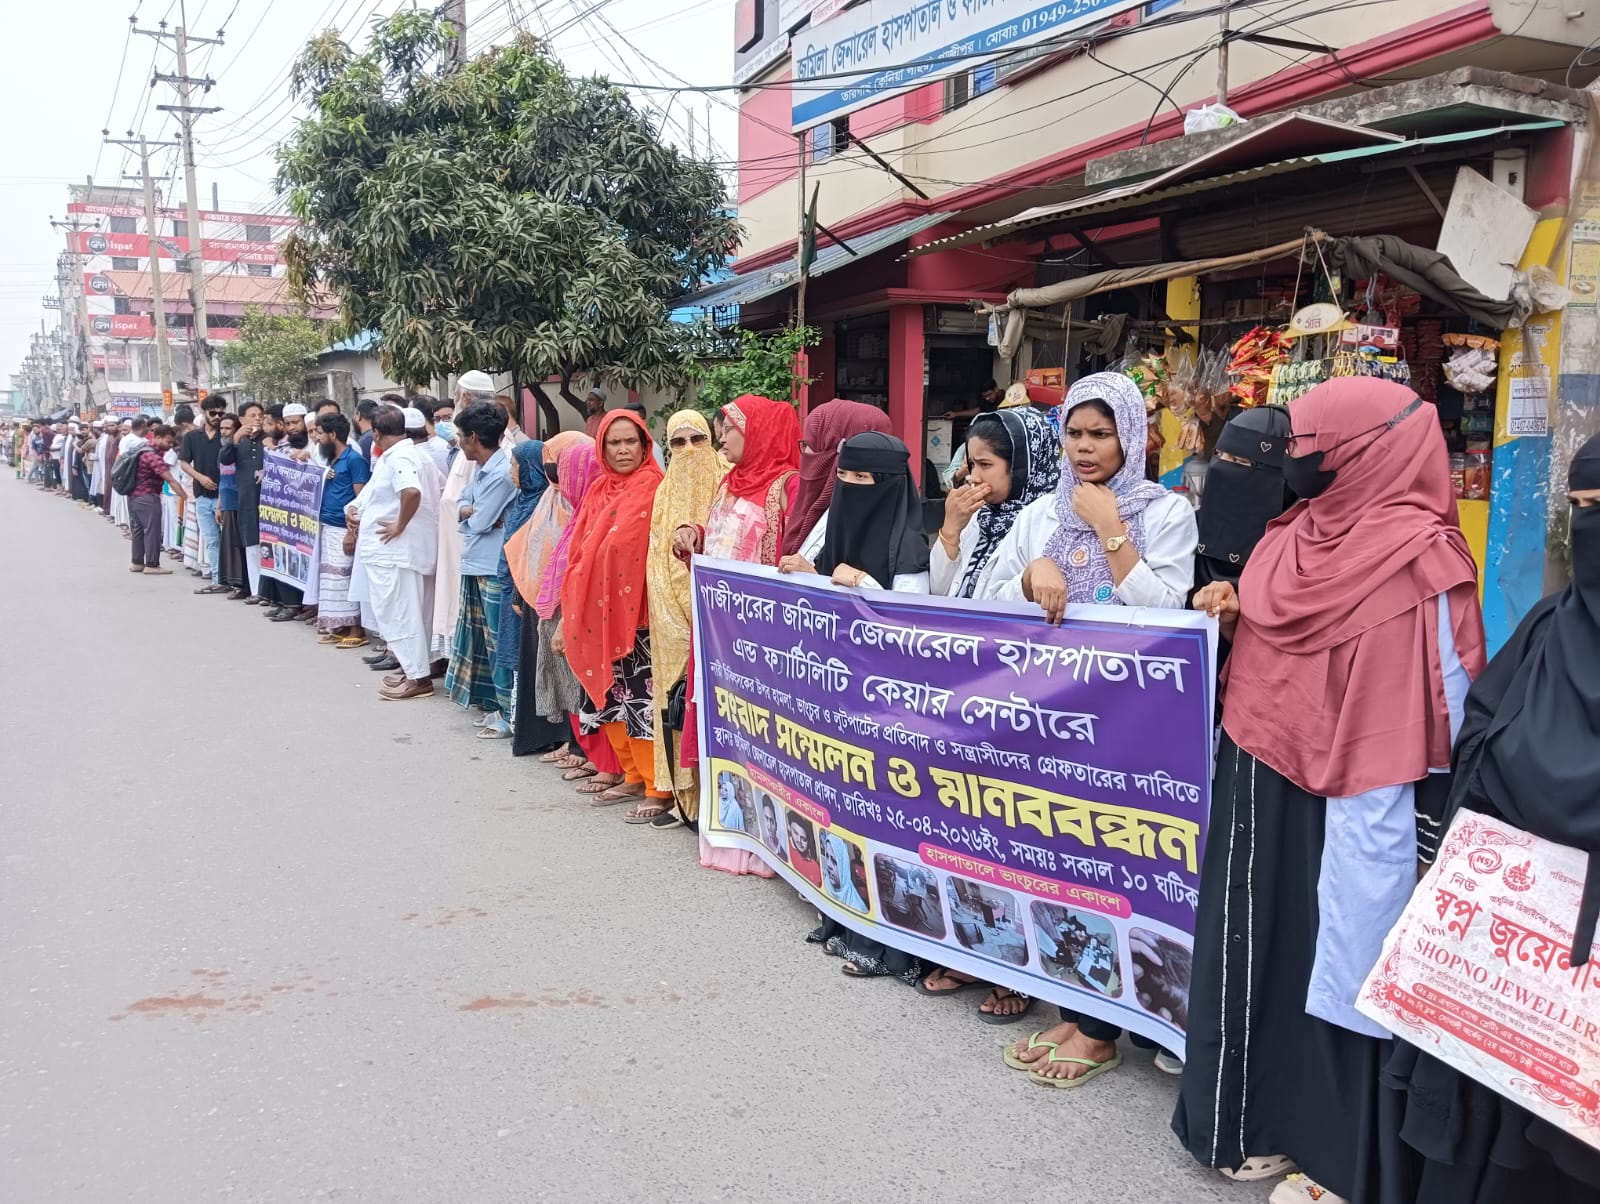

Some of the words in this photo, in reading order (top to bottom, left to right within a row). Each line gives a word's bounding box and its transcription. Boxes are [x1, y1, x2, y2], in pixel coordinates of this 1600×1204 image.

[832, 25, 878, 72] জেনারেল
[881, 0, 941, 54] হাসপাতাল
[701, 580, 776, 624] গাজীপুরের
[781, 598, 840, 641] জমিলা
[850, 619, 985, 667] জেনারেল
[993, 638, 1191, 693] হাসপাতাল
[823, 708, 831, 723] ও
[832, 707, 880, 739] লুটপাটের
[883, 722, 930, 753] প্রতিবাদ
[934, 740, 946, 755] ও
[1038, 755, 1127, 791] গ্রেফতারের
[1131, 770, 1201, 803] দাবিতে
[863, 675, 955, 719] কেয়ার
[961, 691, 1100, 745] সেন্টারে
[714, 686, 770, 744] সংবাদ
[775, 713, 876, 791] সম্মেলন
[887, 757, 921, 797] ও
[928, 766, 1200, 874] মানববন্ধন
[842, 791, 882, 822] তারিখঃ
[1008, 840, 1057, 871] সময়ঃ
[1060, 852, 1114, 885] সকাল
[1121, 865, 1148, 891] ১০
[1152, 870, 1199, 912] ঘটিক
[925, 847, 994, 878] হাসপাতালে
[999, 868, 1060, 896] ভাংচুরের
[1066, 887, 1121, 912] একাংশ
[1450, 872, 1479, 892] নিউ
[1423, 924, 1446, 937] New
[1435, 888, 1483, 941] স্বপ্ন
[1489, 912, 1600, 993] জুয়েলা
[1414, 937, 1488, 984] SHOPNO
[1490, 976, 1600, 1044] JEWELLER
